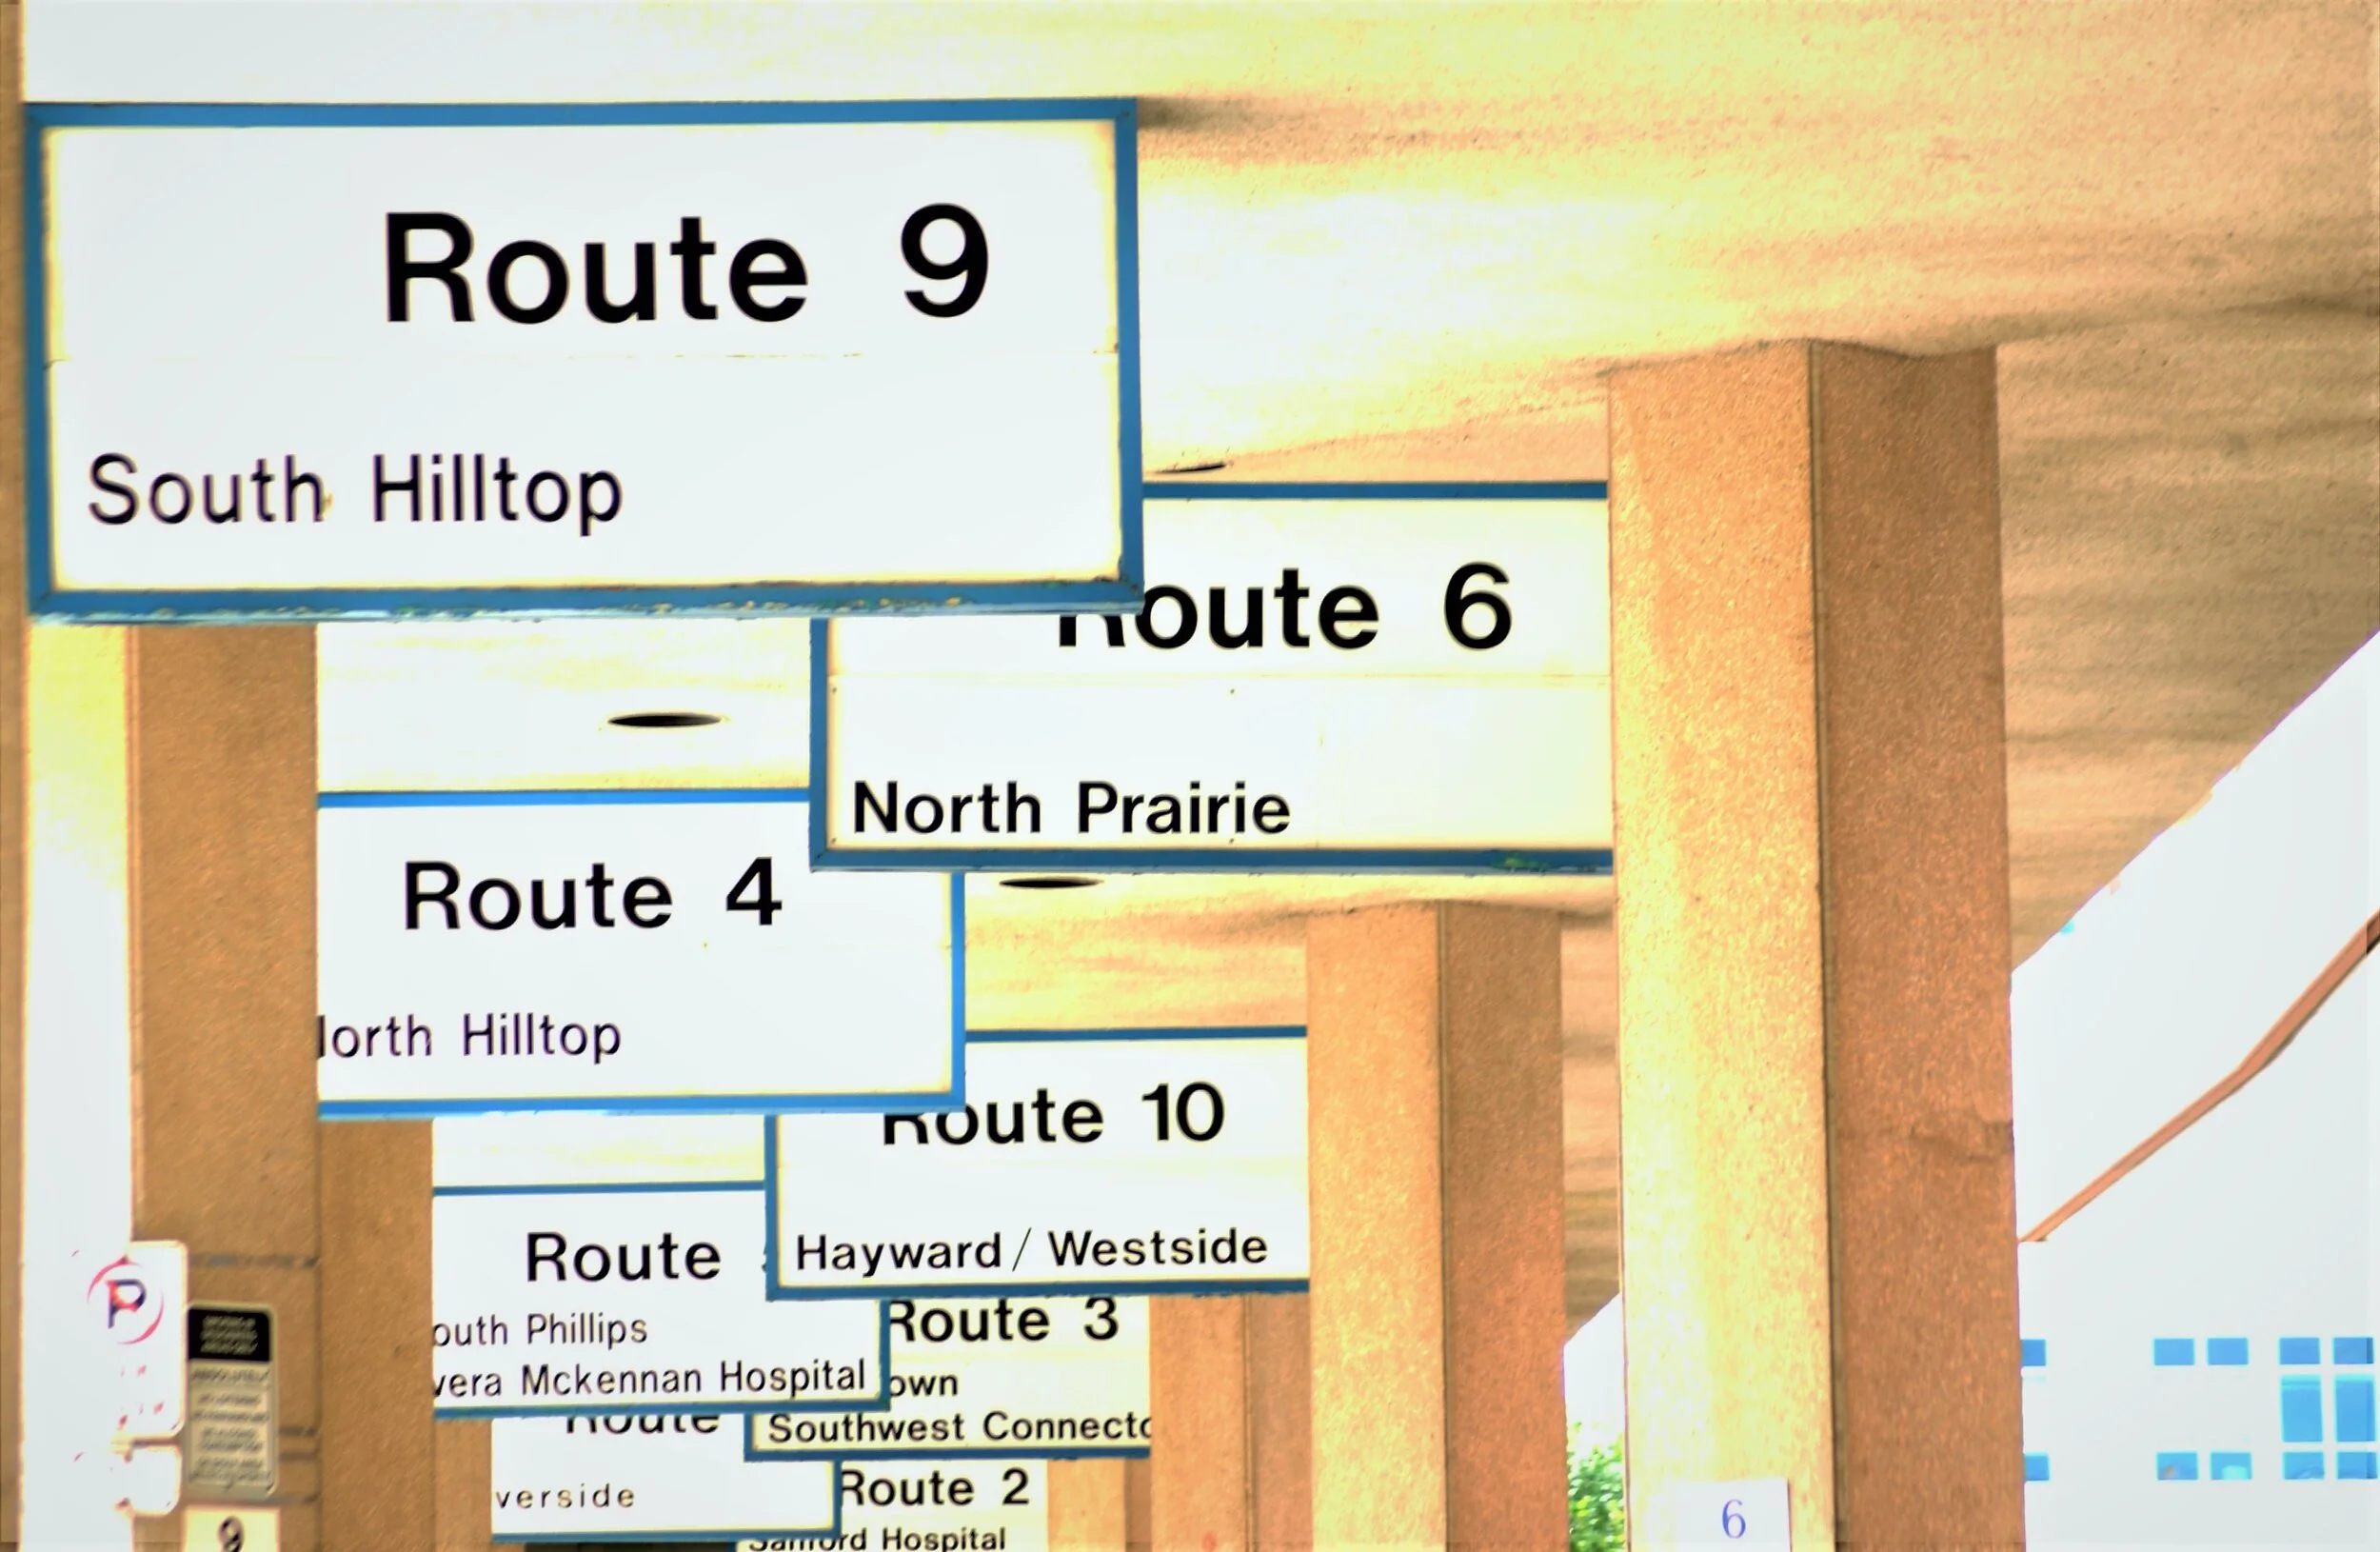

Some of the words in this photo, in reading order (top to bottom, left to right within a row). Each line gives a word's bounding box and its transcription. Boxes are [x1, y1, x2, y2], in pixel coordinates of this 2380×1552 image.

[387, 211, 808, 325] Route
[901, 203, 989, 318] 9
[89, 453, 325, 526] South
[374, 453, 622, 537] Hilltop
[1444, 562, 1512, 650] 6
[854, 781, 1041, 834] North
[1079, 781, 1290, 834] Prairie
[406, 861, 673, 931] Route
[725, 857, 783, 925] 4
[318, 1013, 432, 1058] orth
[464, 1012, 621, 1065] Hilltop
[1141, 1082, 1224, 1142] 10
[527, 1232, 721, 1283] Route
[797, 1232, 1001, 1278] Hayward
[1047, 1227, 1267, 1266] Westside
[527, 1311, 647, 1350] Phillips
[890, 1300, 1050, 1343] Route
[1084, 1298, 1119, 1341] 3
[522, 1363, 703, 1396] Mckennan
[721, 1358, 865, 1399] Hospital
[768, 1412, 965, 1443] Southwest
[842, 1469, 974, 1506] Route
[1002, 1466, 1030, 1505] 2
[883, 1527, 1006, 1552] Hospital
[1721, 1499, 1747, 1539] 6
